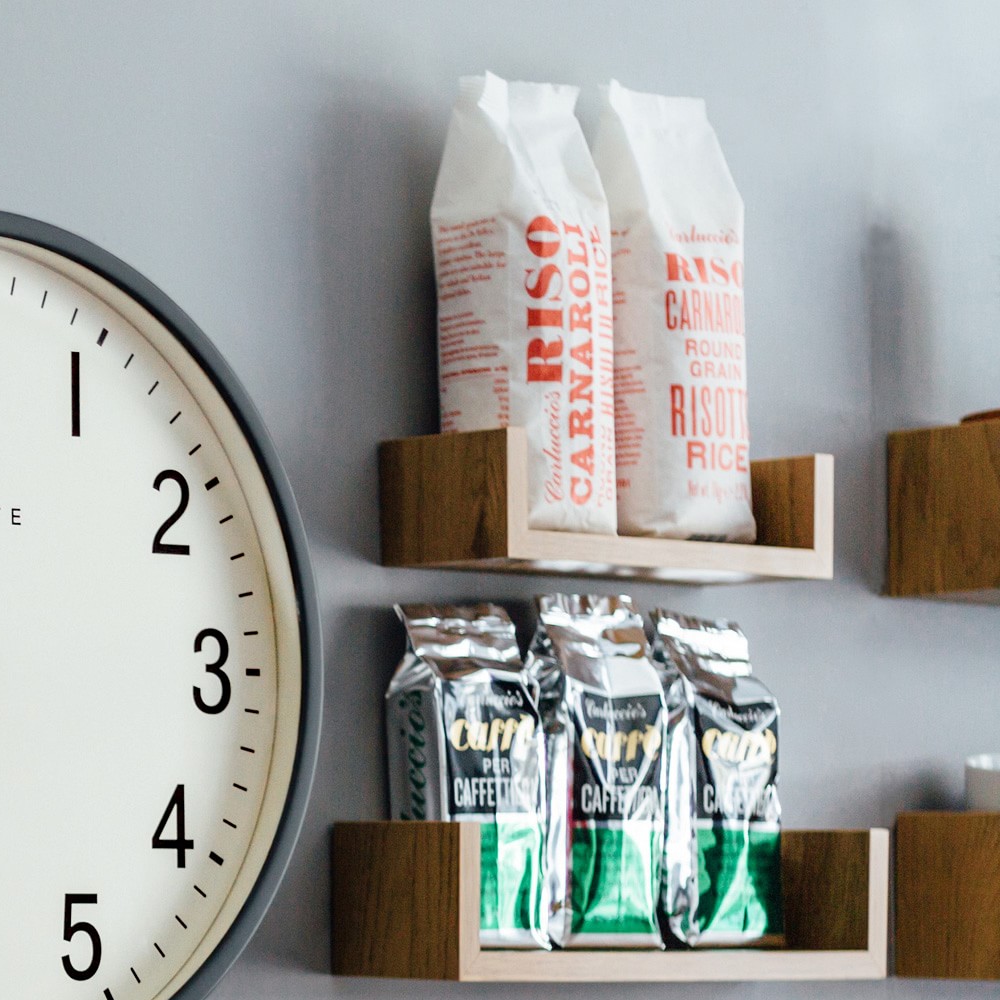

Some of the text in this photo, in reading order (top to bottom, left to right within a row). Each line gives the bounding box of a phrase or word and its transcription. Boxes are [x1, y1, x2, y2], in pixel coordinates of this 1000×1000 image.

[524, 215, 563, 384] RISO
[562, 220, 594, 506] CARNAROLI
[685, 338, 743, 361] ROUND
[690, 360, 742, 380] GRAIN
[71, 352, 81, 437] 1
[686, 440, 748, 473] RICE
[152, 470, 190, 556] 2
[193, 628, 232, 714] 3
[152, 784, 195, 869] 4
[61, 893, 102, 982] 5
